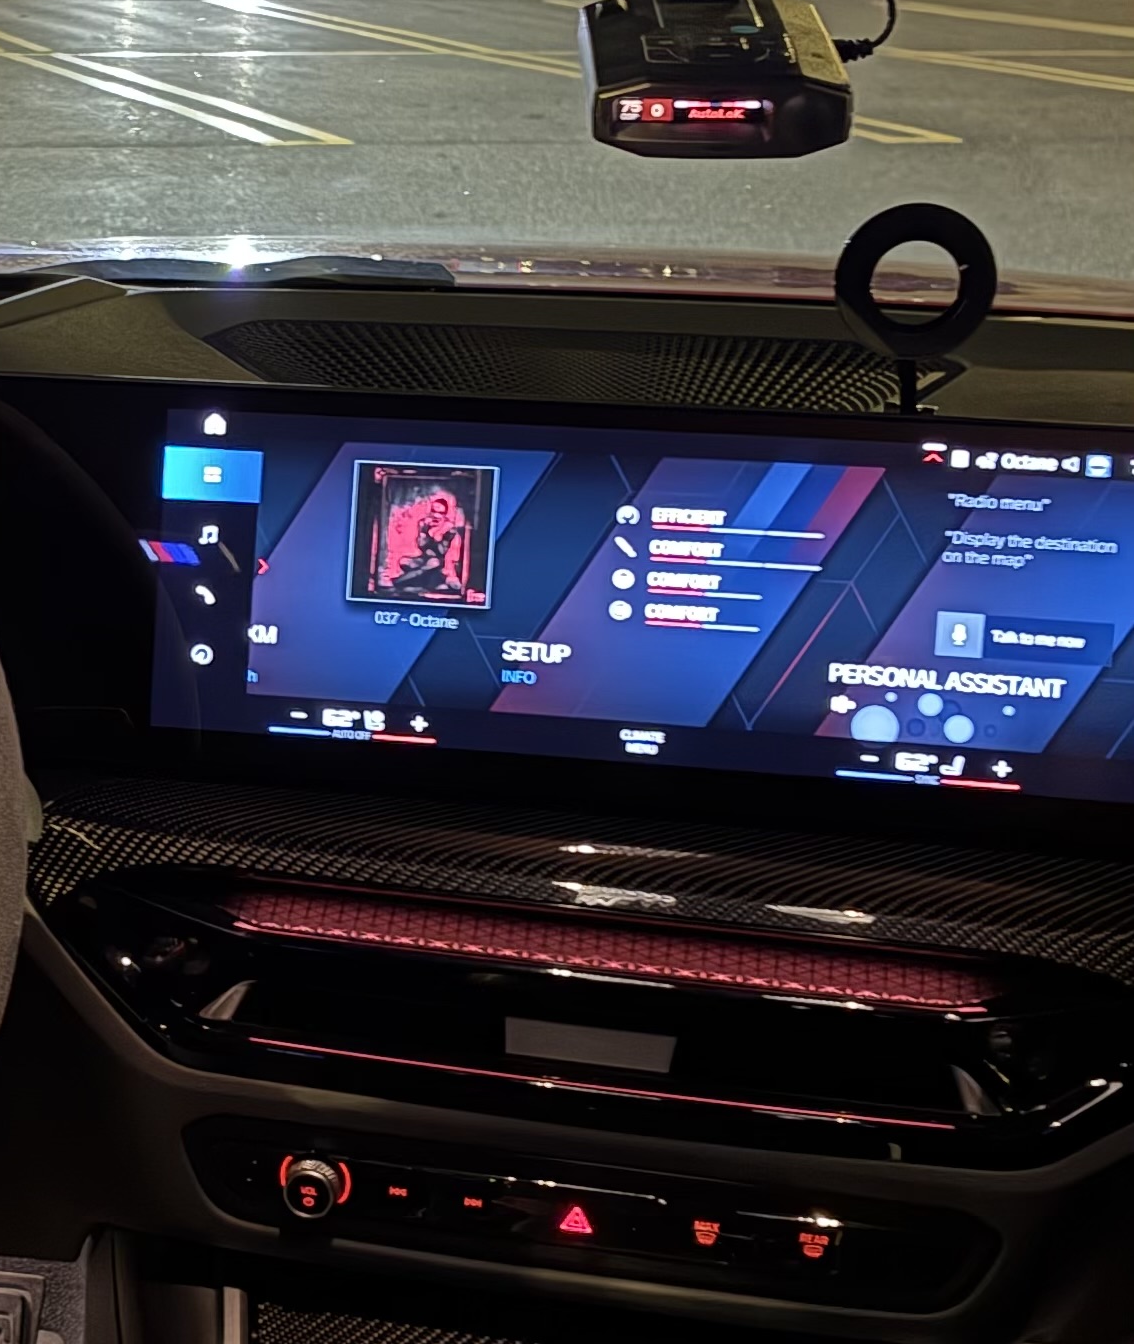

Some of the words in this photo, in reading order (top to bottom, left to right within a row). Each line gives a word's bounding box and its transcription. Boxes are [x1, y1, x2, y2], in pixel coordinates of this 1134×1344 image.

[619, 99, 643, 113] 75
[1000, 452, 1060, 472] Octane
[650, 506, 728, 526] EFFICIENT
[648, 539, 726, 558] COMFORT
[1007, 533, 1033, 549] the
[1034, 536, 1118, 554] destination
[941, 551, 962, 563] on
[964, 550, 990, 565] the
[646, 571, 723, 590] COMFORT
[374, 611, 400, 625] 037
[409, 613, 460, 629] Octane
[644, 603, 721, 622] COMFORT
[501, 640, 572, 663] SETUP
[501, 669, 537, 685] INFO
[828, 662, 943, 690] PERSONAL
[944, 671, 1067, 699] ASSISTANT
[694, 1220, 720, 1233] MAX
[798, 1232, 829, 1245] REAR
